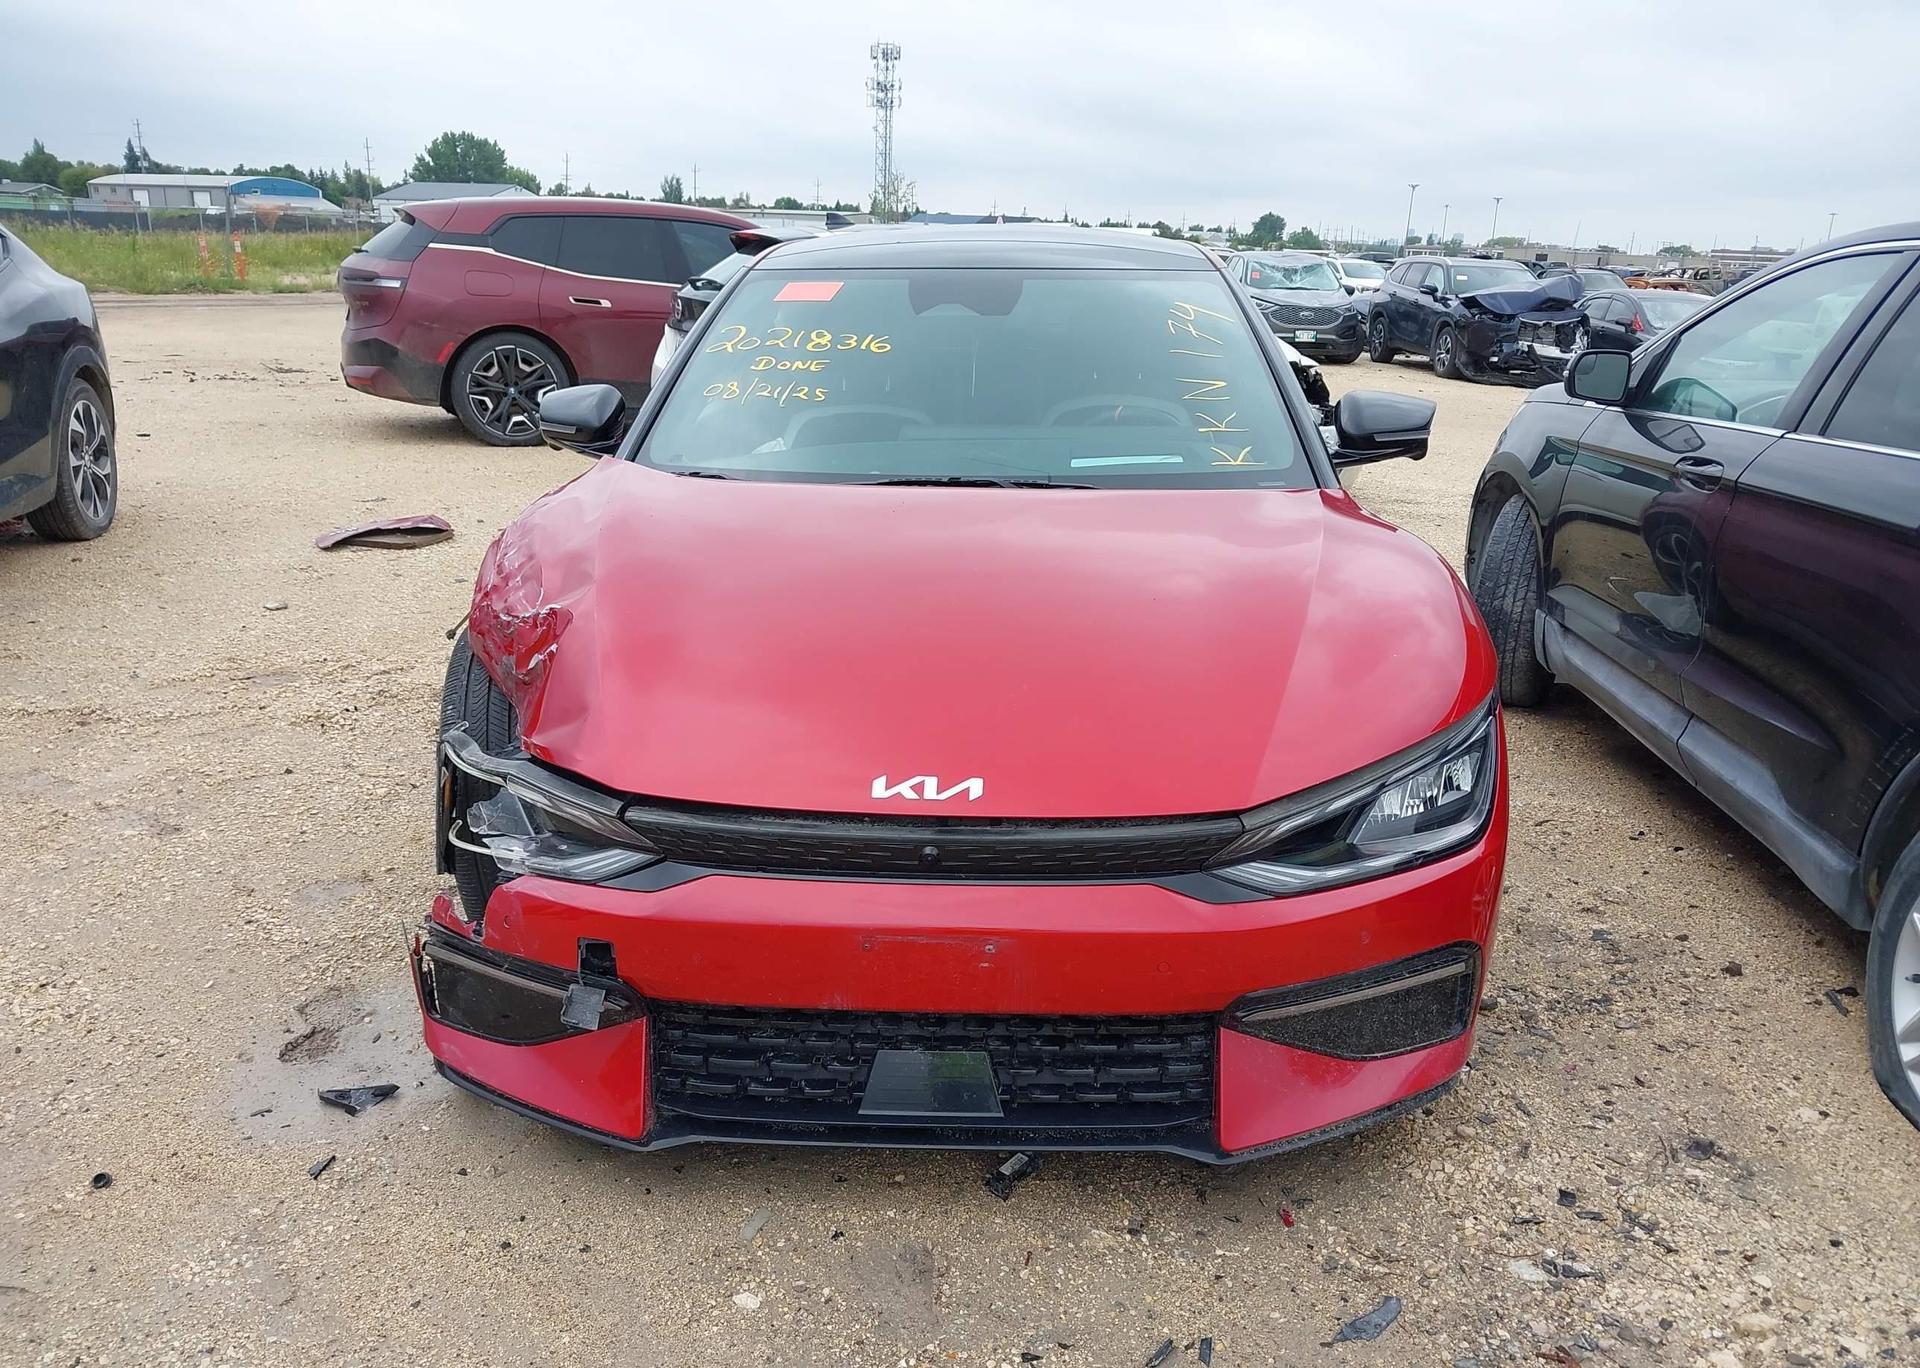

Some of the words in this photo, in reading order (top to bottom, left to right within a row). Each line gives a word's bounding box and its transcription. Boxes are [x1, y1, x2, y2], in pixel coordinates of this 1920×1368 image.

[706, 325, 892, 354] 20218316
[750, 355, 831, 372] DONE
[703, 377, 829, 408] 08/21/25
[871, 774, 985, 802] KIA
